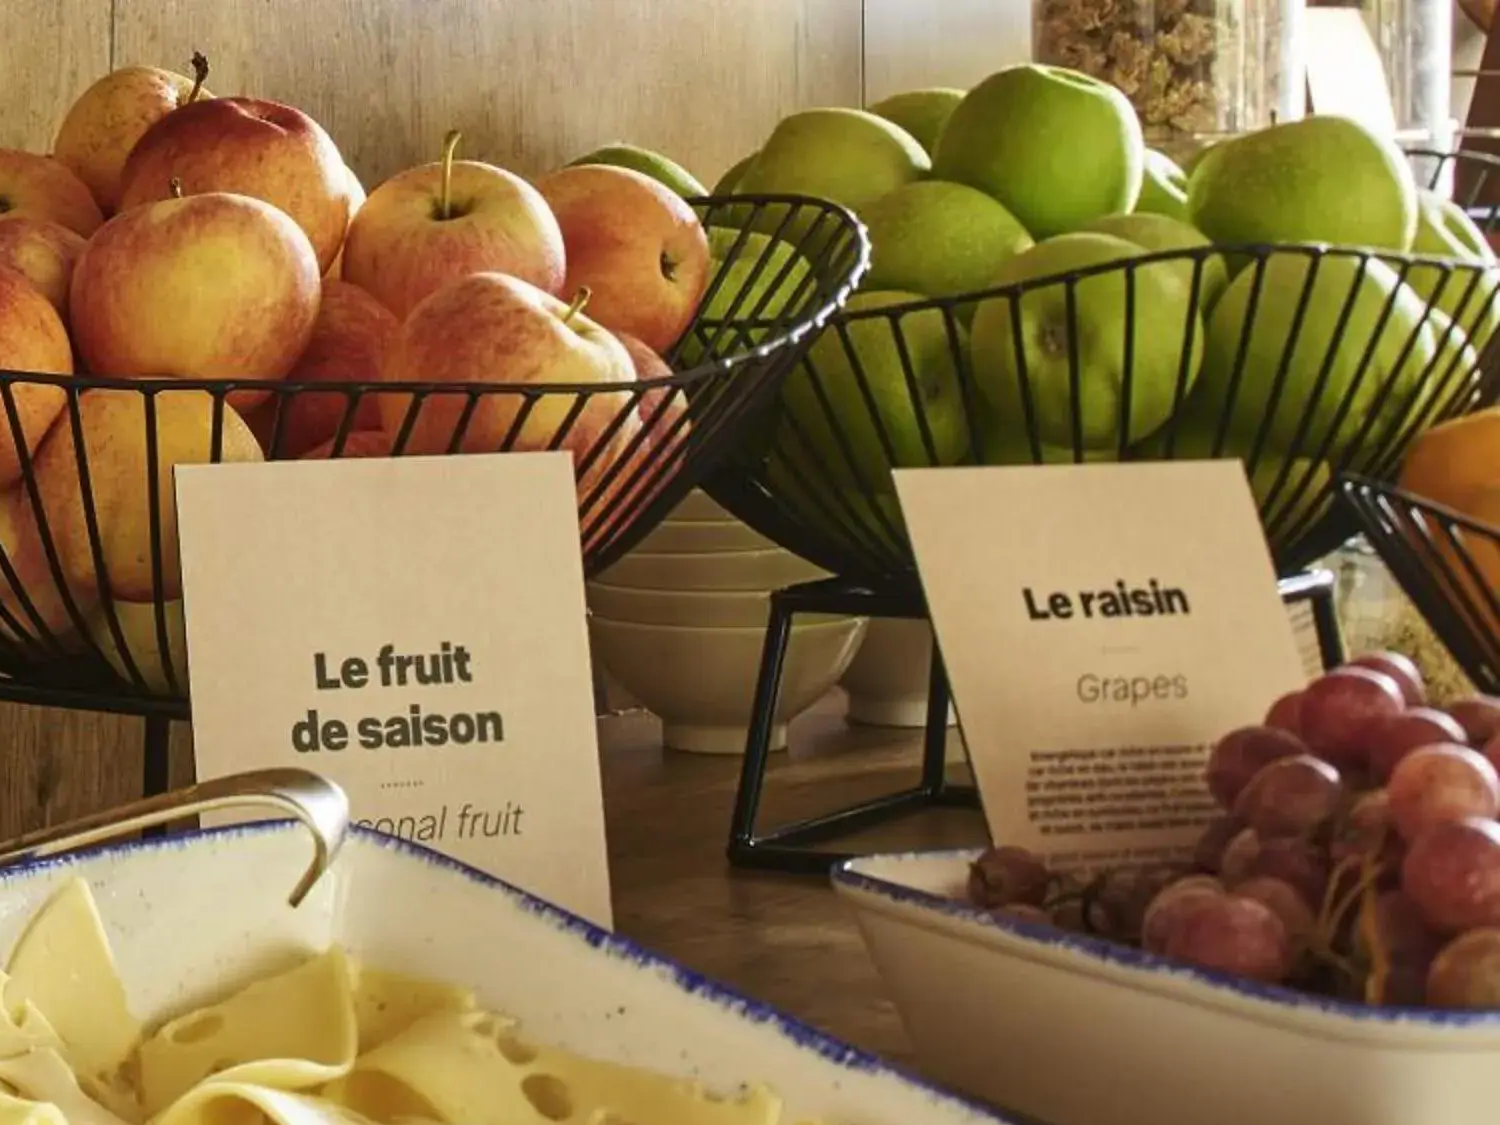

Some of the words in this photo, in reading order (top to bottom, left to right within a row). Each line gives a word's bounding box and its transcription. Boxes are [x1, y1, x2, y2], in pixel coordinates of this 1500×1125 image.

[1022, 587, 1074, 620] Le
[1078, 578, 1190, 619] raisin
[313, 652, 369, 690] Le
[376, 641, 473, 687] fruit
[1076, 672, 1189, 707] Grapes
[291, 709, 349, 752] de
[357, 703, 504, 750] saison
[458, 800, 524, 839] fruit
